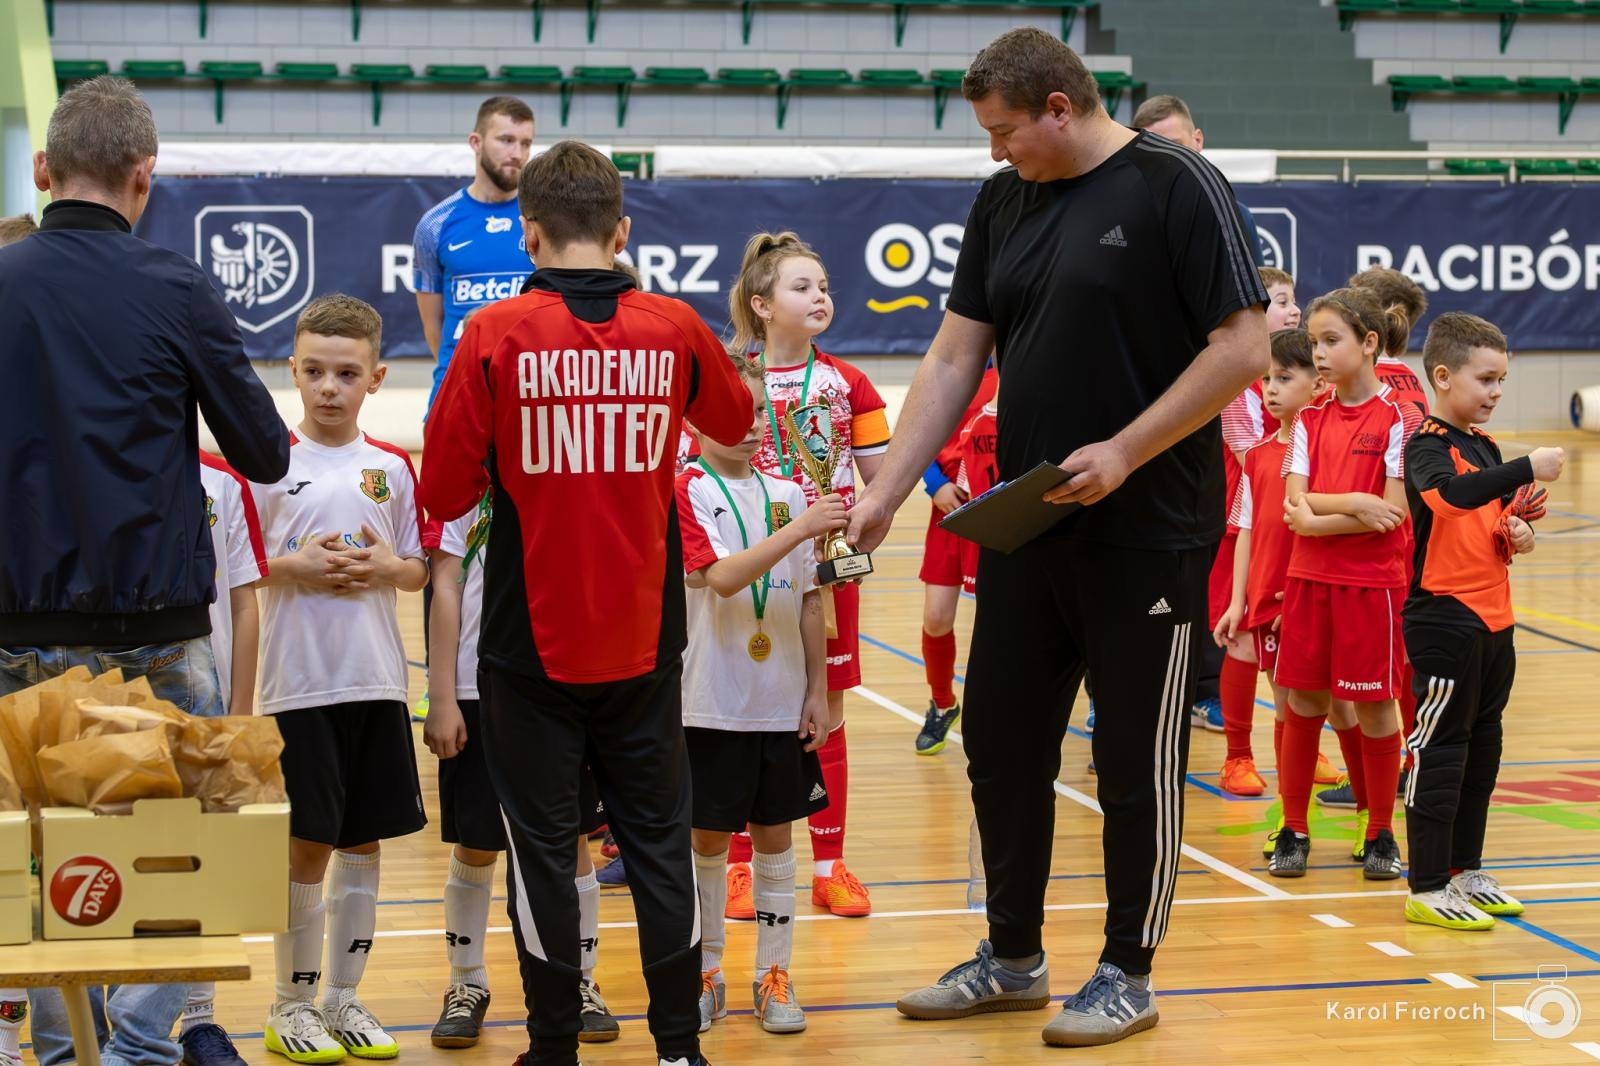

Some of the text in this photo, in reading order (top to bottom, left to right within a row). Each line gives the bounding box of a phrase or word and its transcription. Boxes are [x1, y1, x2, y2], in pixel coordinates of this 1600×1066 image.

[865, 223, 965, 288] OS
[456, 276, 526, 301] Betcli
[518, 349, 675, 399] AKADEMIA
[520, 403, 671, 475] UNITED
[972, 434, 997, 454] KIE
[825, 653, 852, 665] egio
[1264, 635, 1277, 652] 8
[1345, 681, 1383, 691] PATRICK
[61, 865, 104, 919] 7
[83, 868, 116, 917] DAYS
